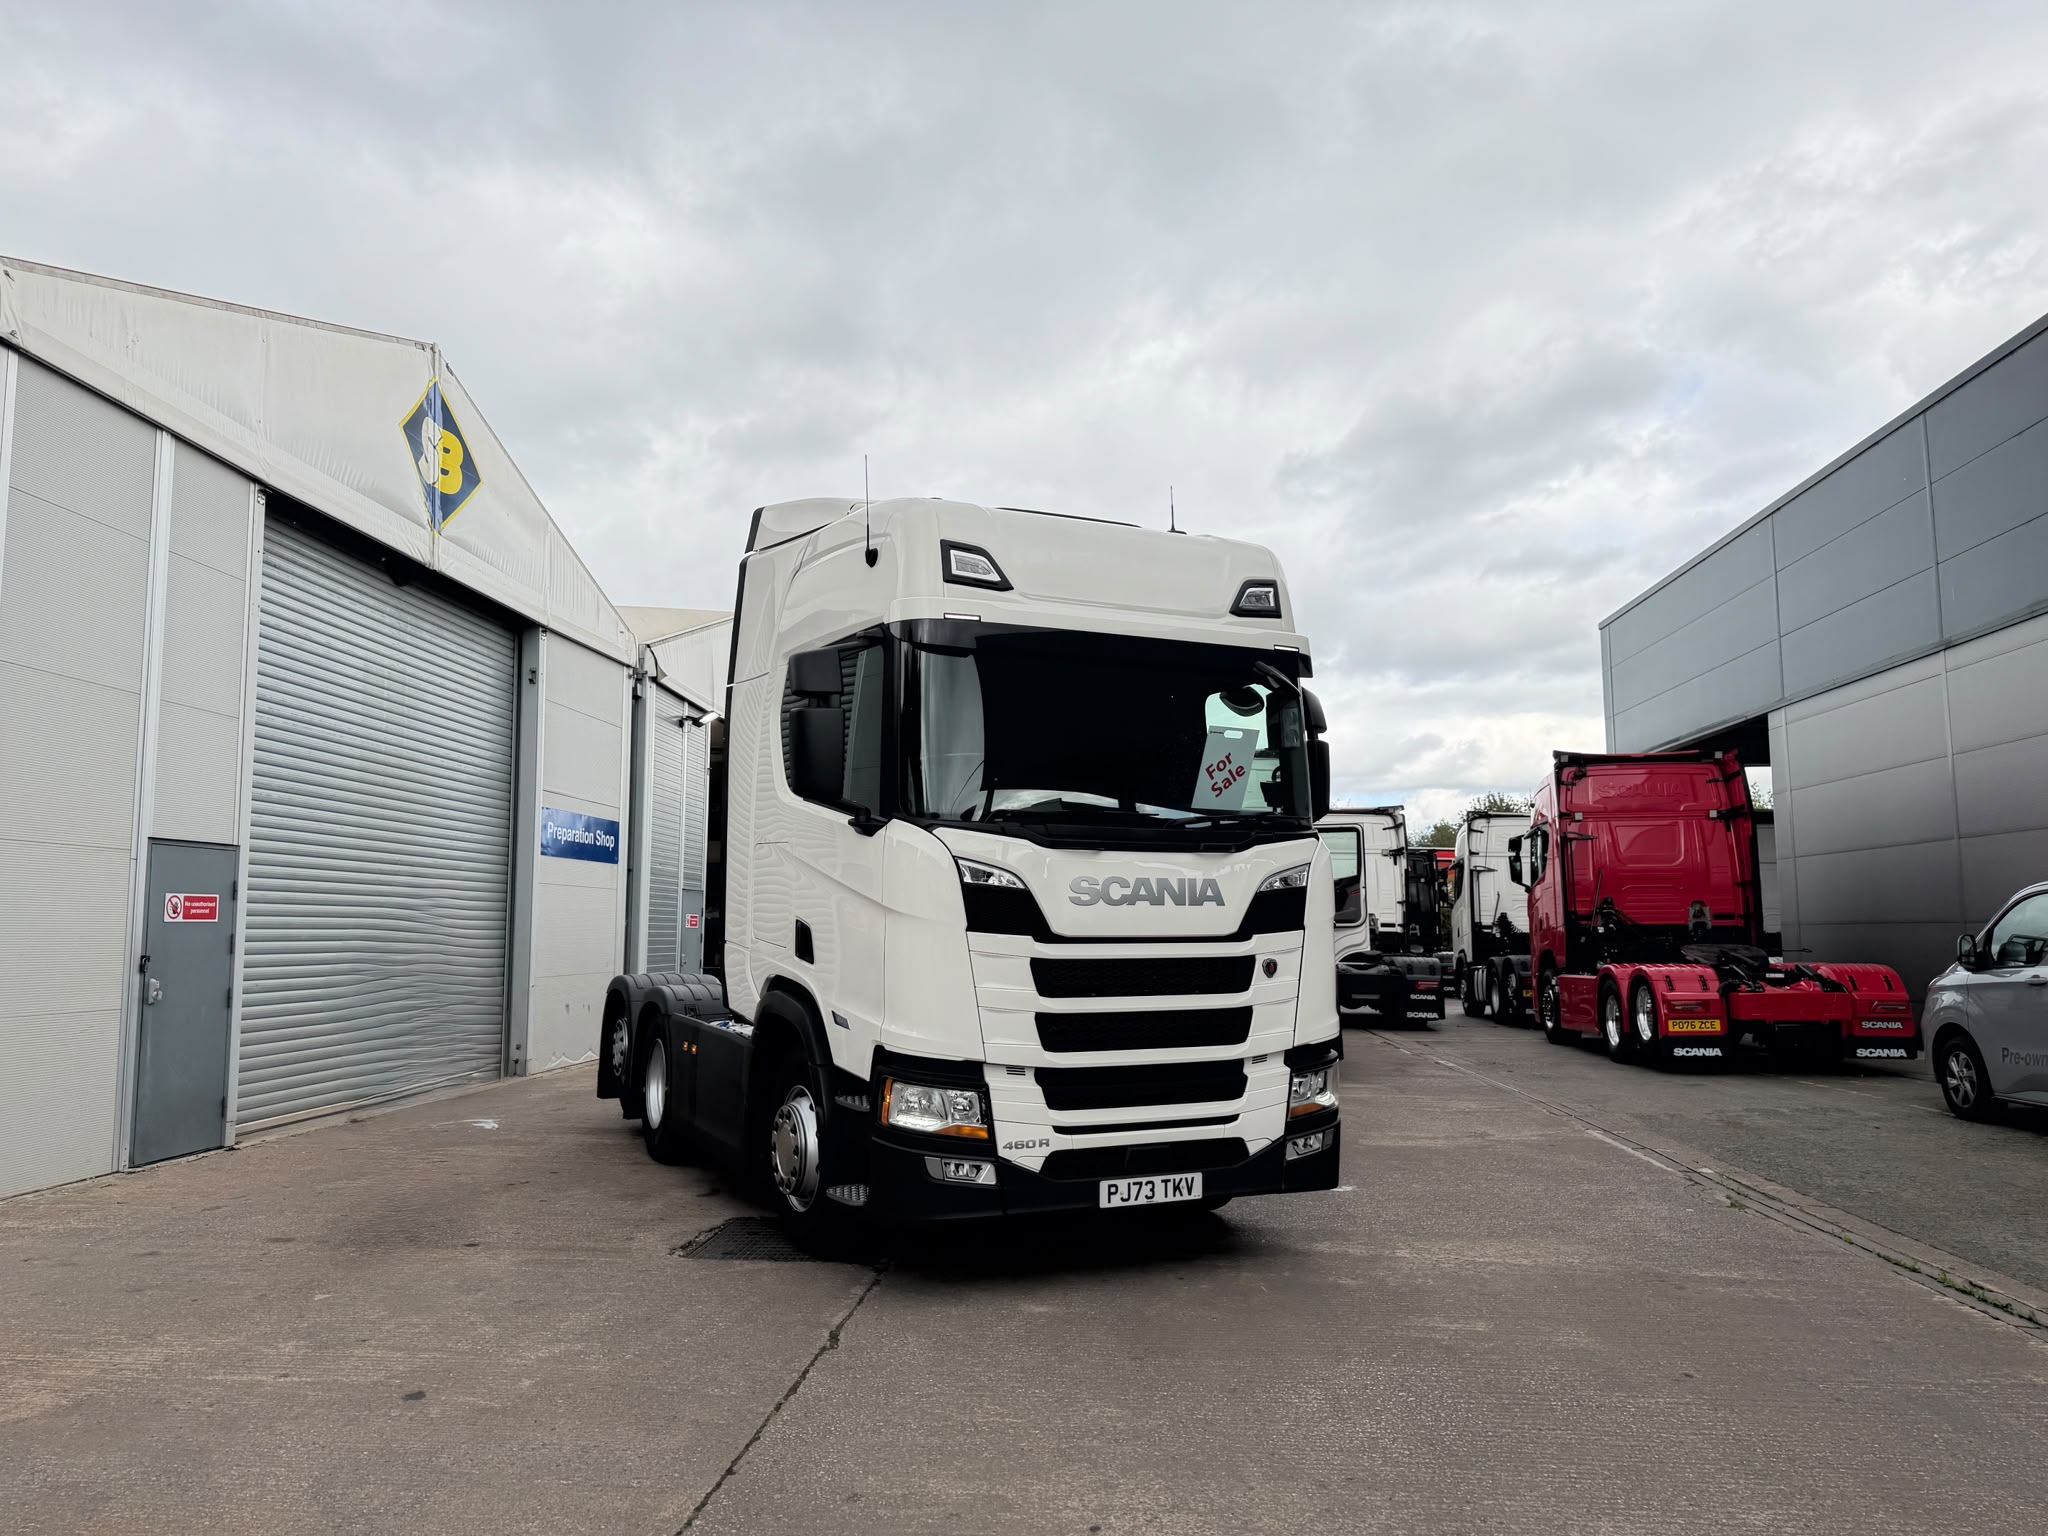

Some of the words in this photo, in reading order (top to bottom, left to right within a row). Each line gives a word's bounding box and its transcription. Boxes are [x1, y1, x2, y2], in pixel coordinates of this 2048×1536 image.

[1205, 752, 1232, 781] For
[1211, 765, 1246, 798] Sale
[547, 821, 594, 845] Preparation
[595, 829, 615, 851] Shop
[1068, 875, 1226, 907] SCANIA
[1406, 1011, 1439, 1019] SCANIA
[1861, 1021, 1904, 1029] SCANIA
[1673, 1047, 1723, 1057] SCANIA
[1856, 1048, 1908, 1058] SCANIA
[1002, 1140, 1036, 1150] 460
[1038, 1138, 1050, 1148] R
[1107, 1180, 1155, 1204] PJ73
[1161, 1176, 1195, 1198] TKV
